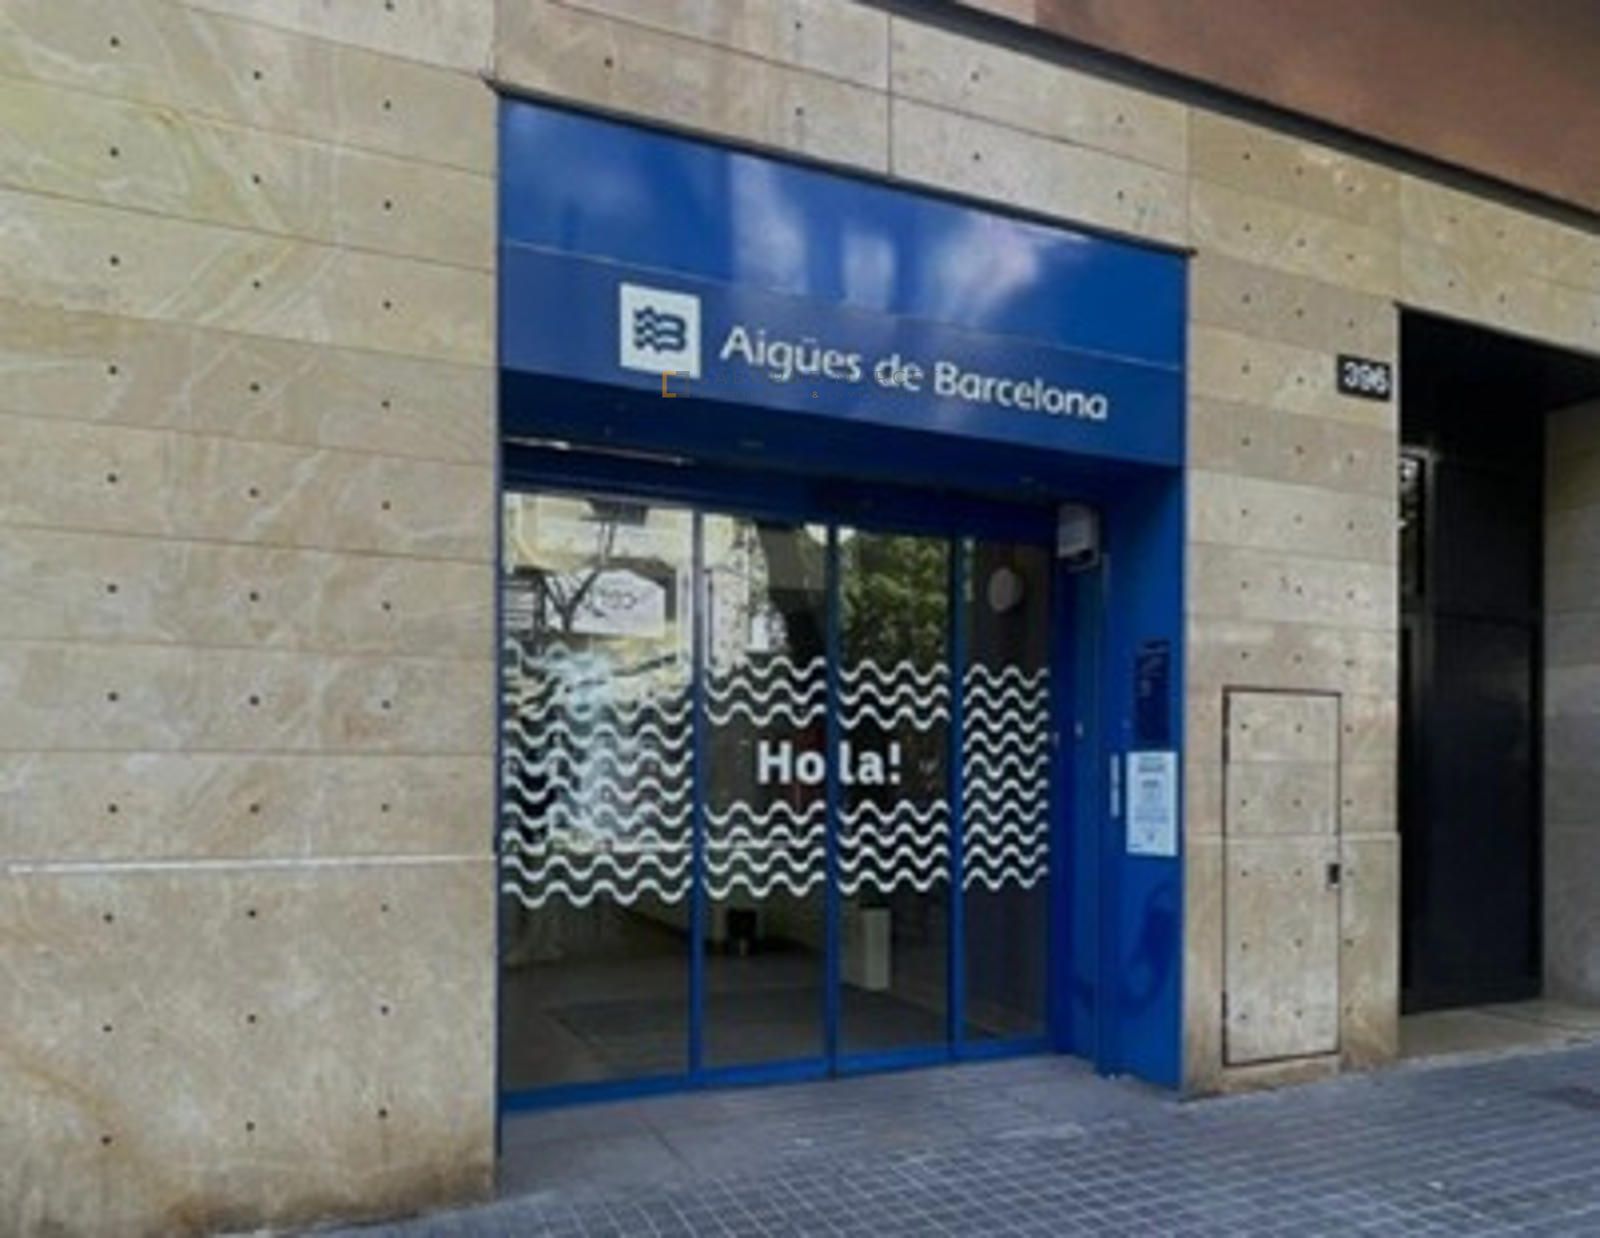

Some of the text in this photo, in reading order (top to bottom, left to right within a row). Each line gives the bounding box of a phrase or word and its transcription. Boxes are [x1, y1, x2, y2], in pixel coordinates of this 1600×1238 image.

[720, 326, 1108, 421] Aigües de Barcelona
[1344, 361, 1388, 394] 396
